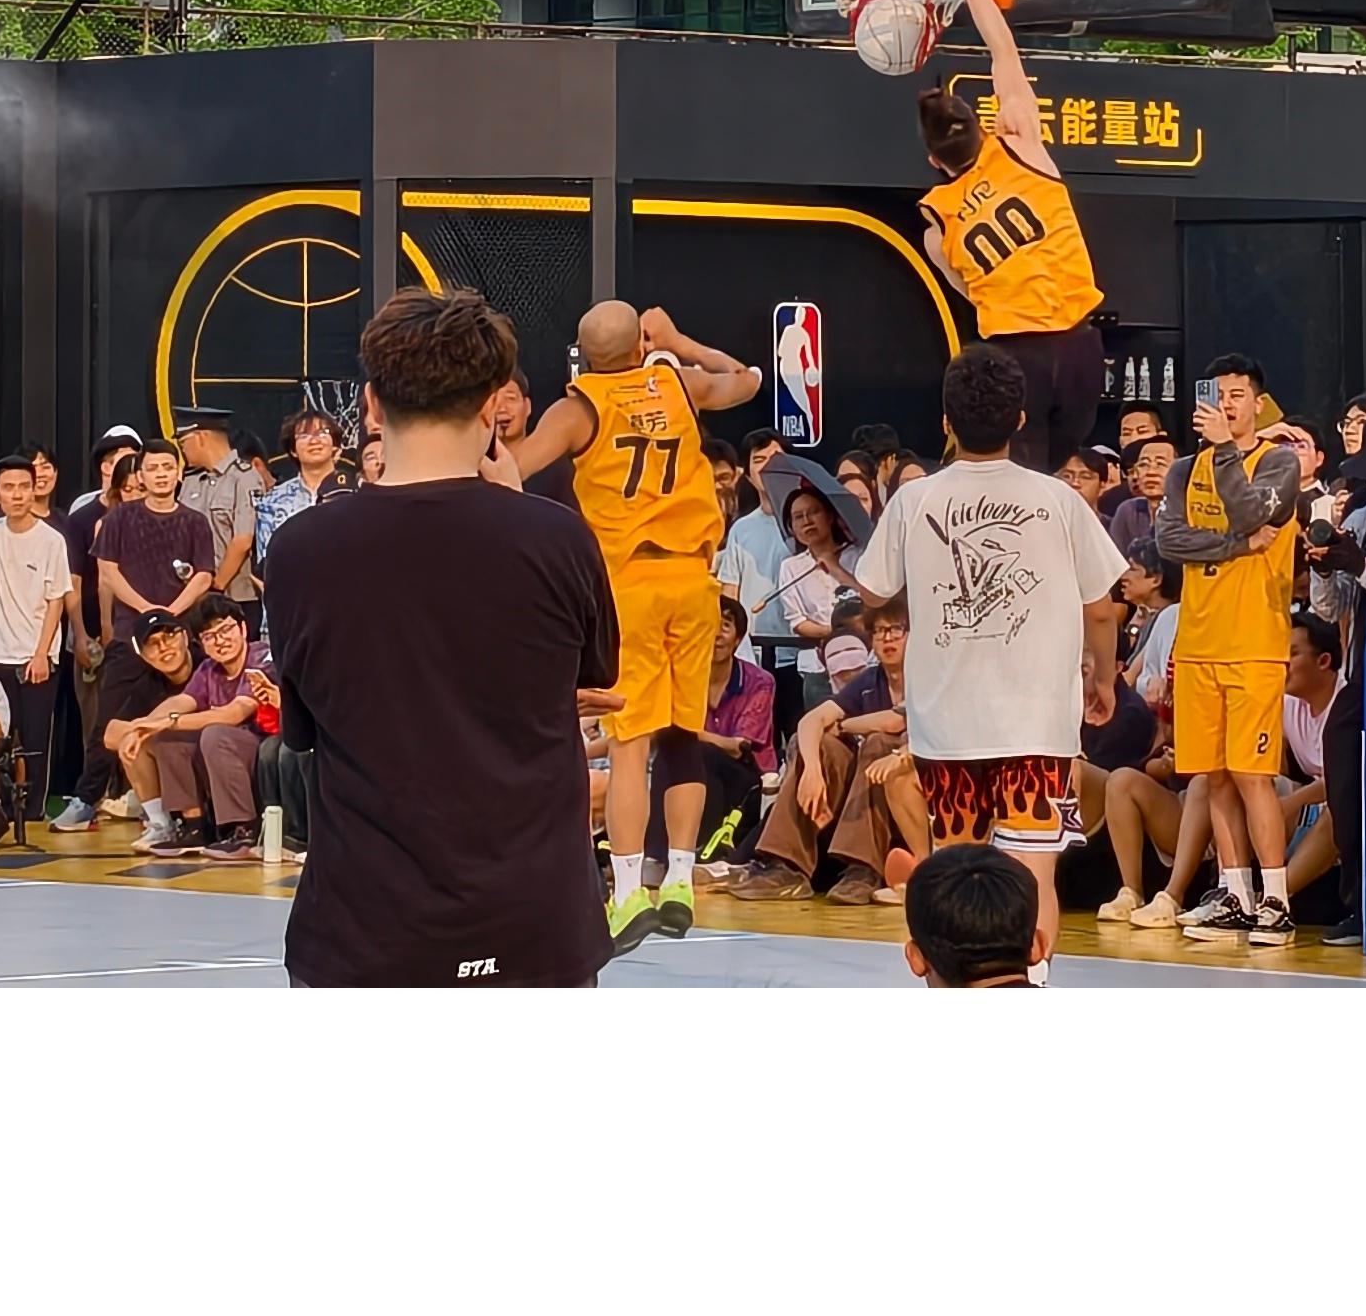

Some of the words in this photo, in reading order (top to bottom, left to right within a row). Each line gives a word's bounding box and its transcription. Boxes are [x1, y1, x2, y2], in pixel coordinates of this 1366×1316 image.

[782, 414, 805, 437] NBA
[615, 435, 682, 499] 77
[1257, 732, 1269, 755] 2
